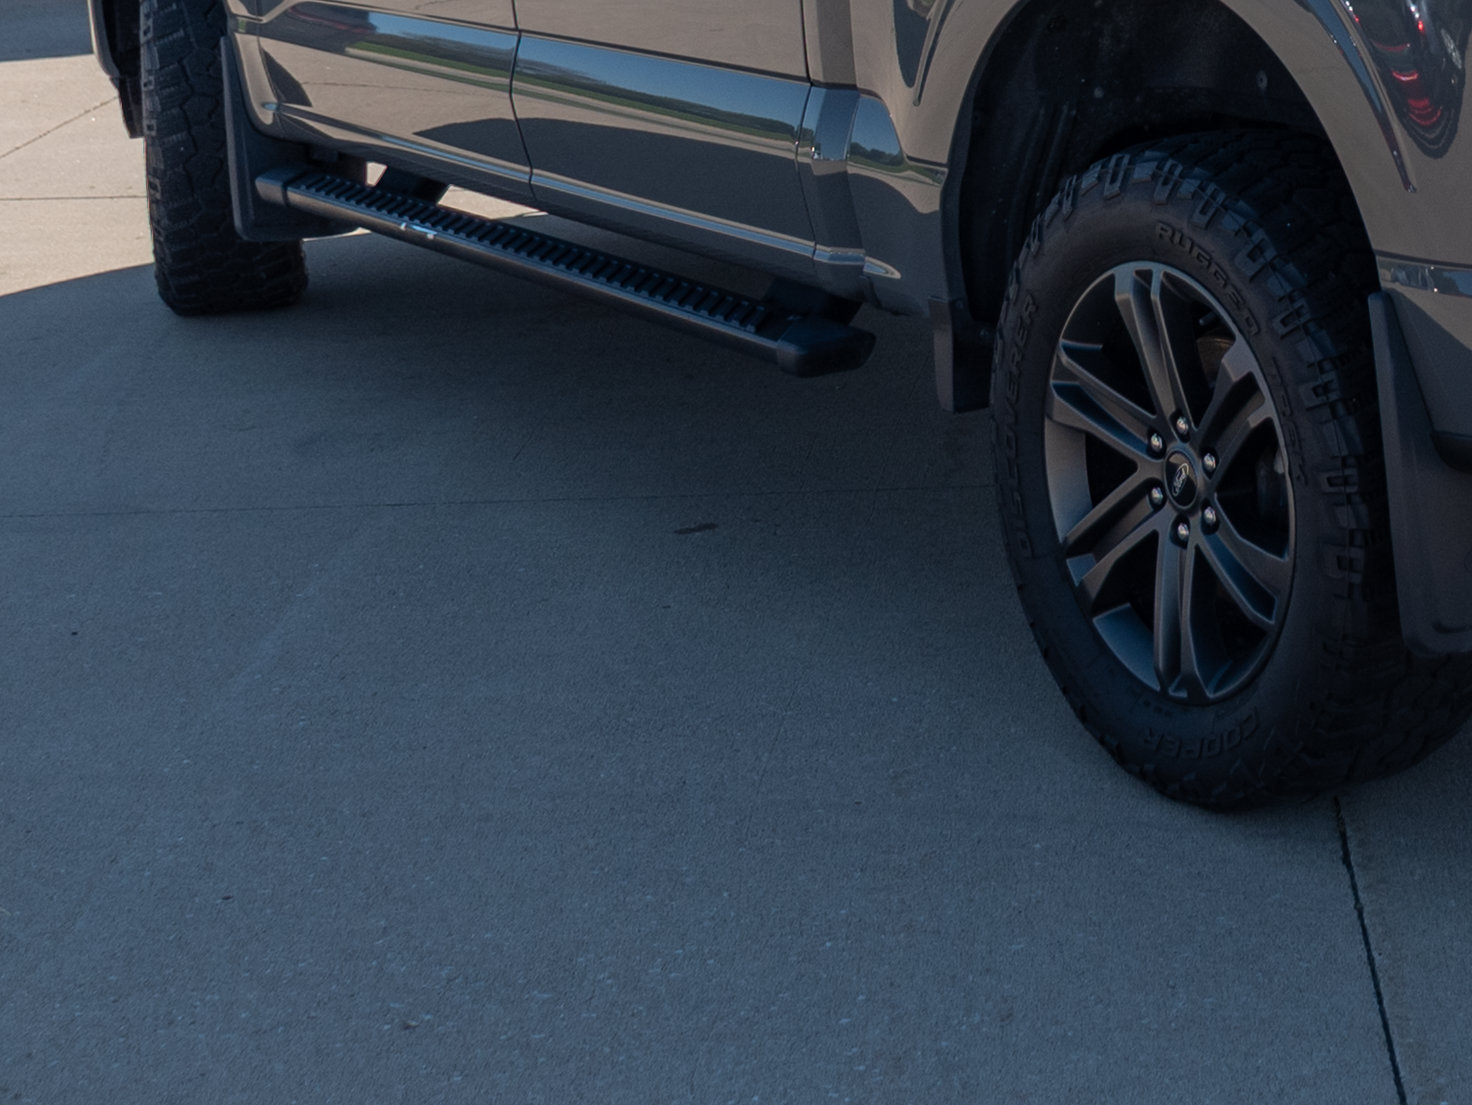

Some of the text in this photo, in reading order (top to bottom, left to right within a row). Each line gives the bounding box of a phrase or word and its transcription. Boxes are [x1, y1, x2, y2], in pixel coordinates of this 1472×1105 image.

[1156, 219, 1260, 336] RUGGED
[1006, 290, 1039, 559] DISCOVERER
[1143, 706, 1260, 760] COOPER
